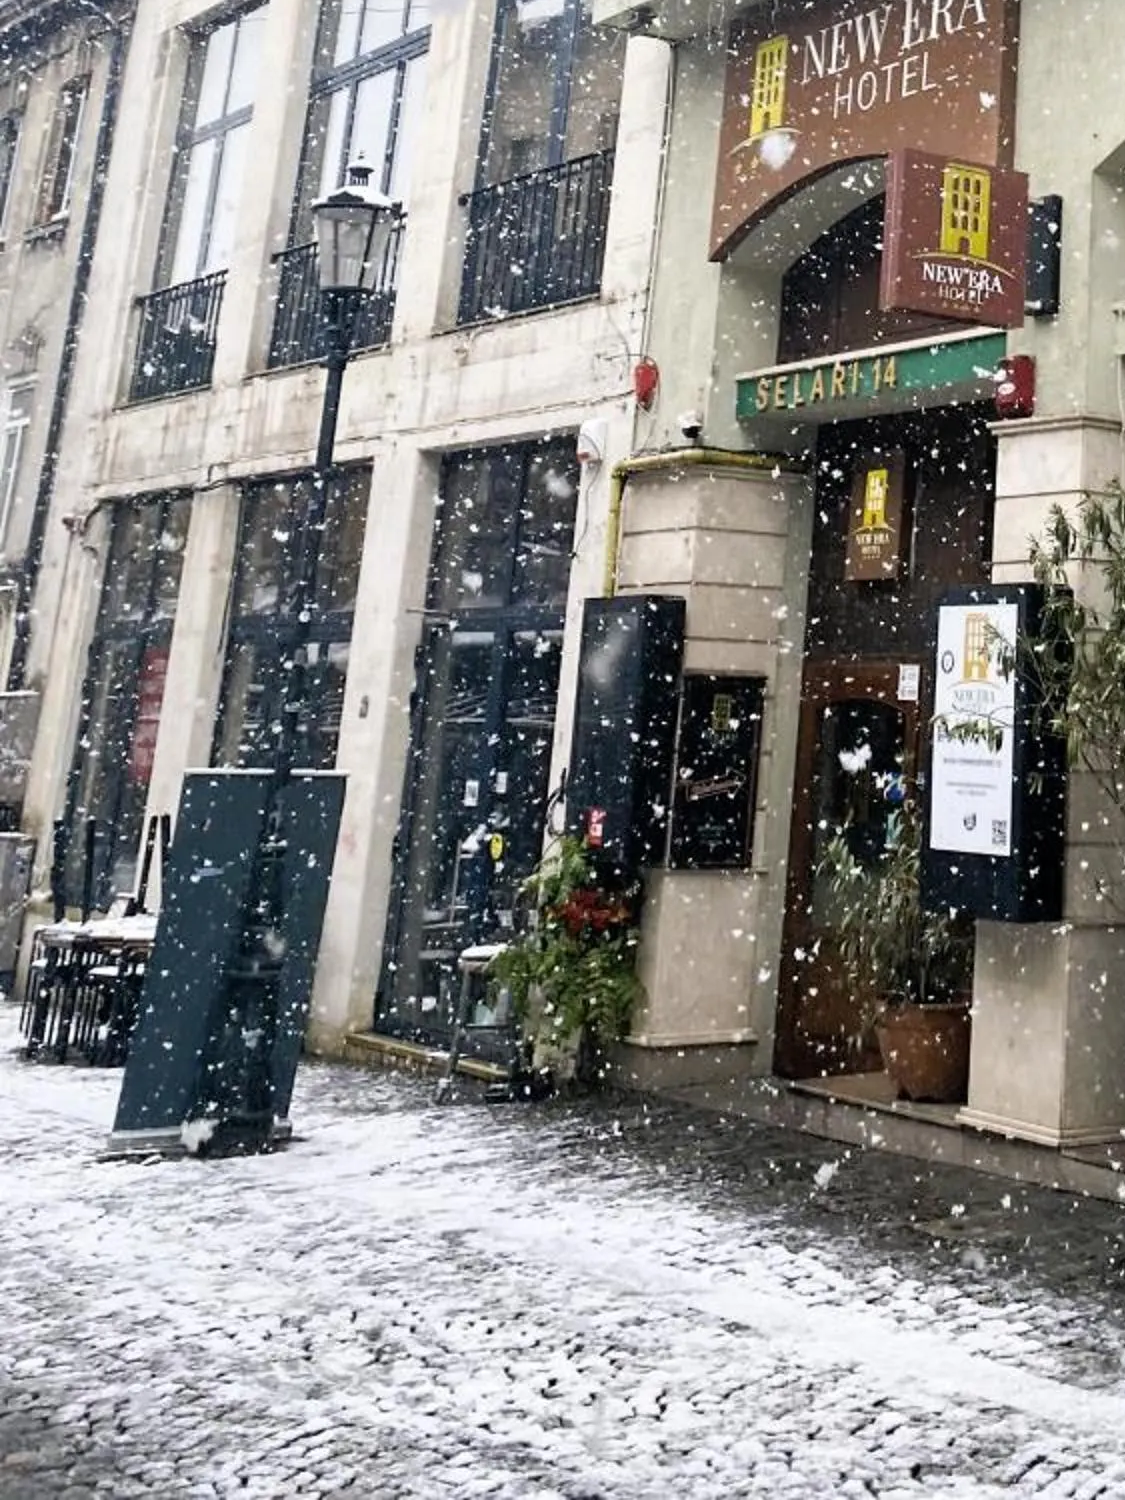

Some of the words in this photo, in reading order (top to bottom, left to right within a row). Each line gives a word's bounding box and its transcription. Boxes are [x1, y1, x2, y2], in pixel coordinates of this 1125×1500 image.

[801, 3, 893, 85] NEW
[832, 51, 937, 119] HOTEL
[922, 261, 963, 285] NEW
[968, 268, 1006, 297] ERA
[755, 355, 860, 412] SELARI
[871, 355, 897, 393] 14
